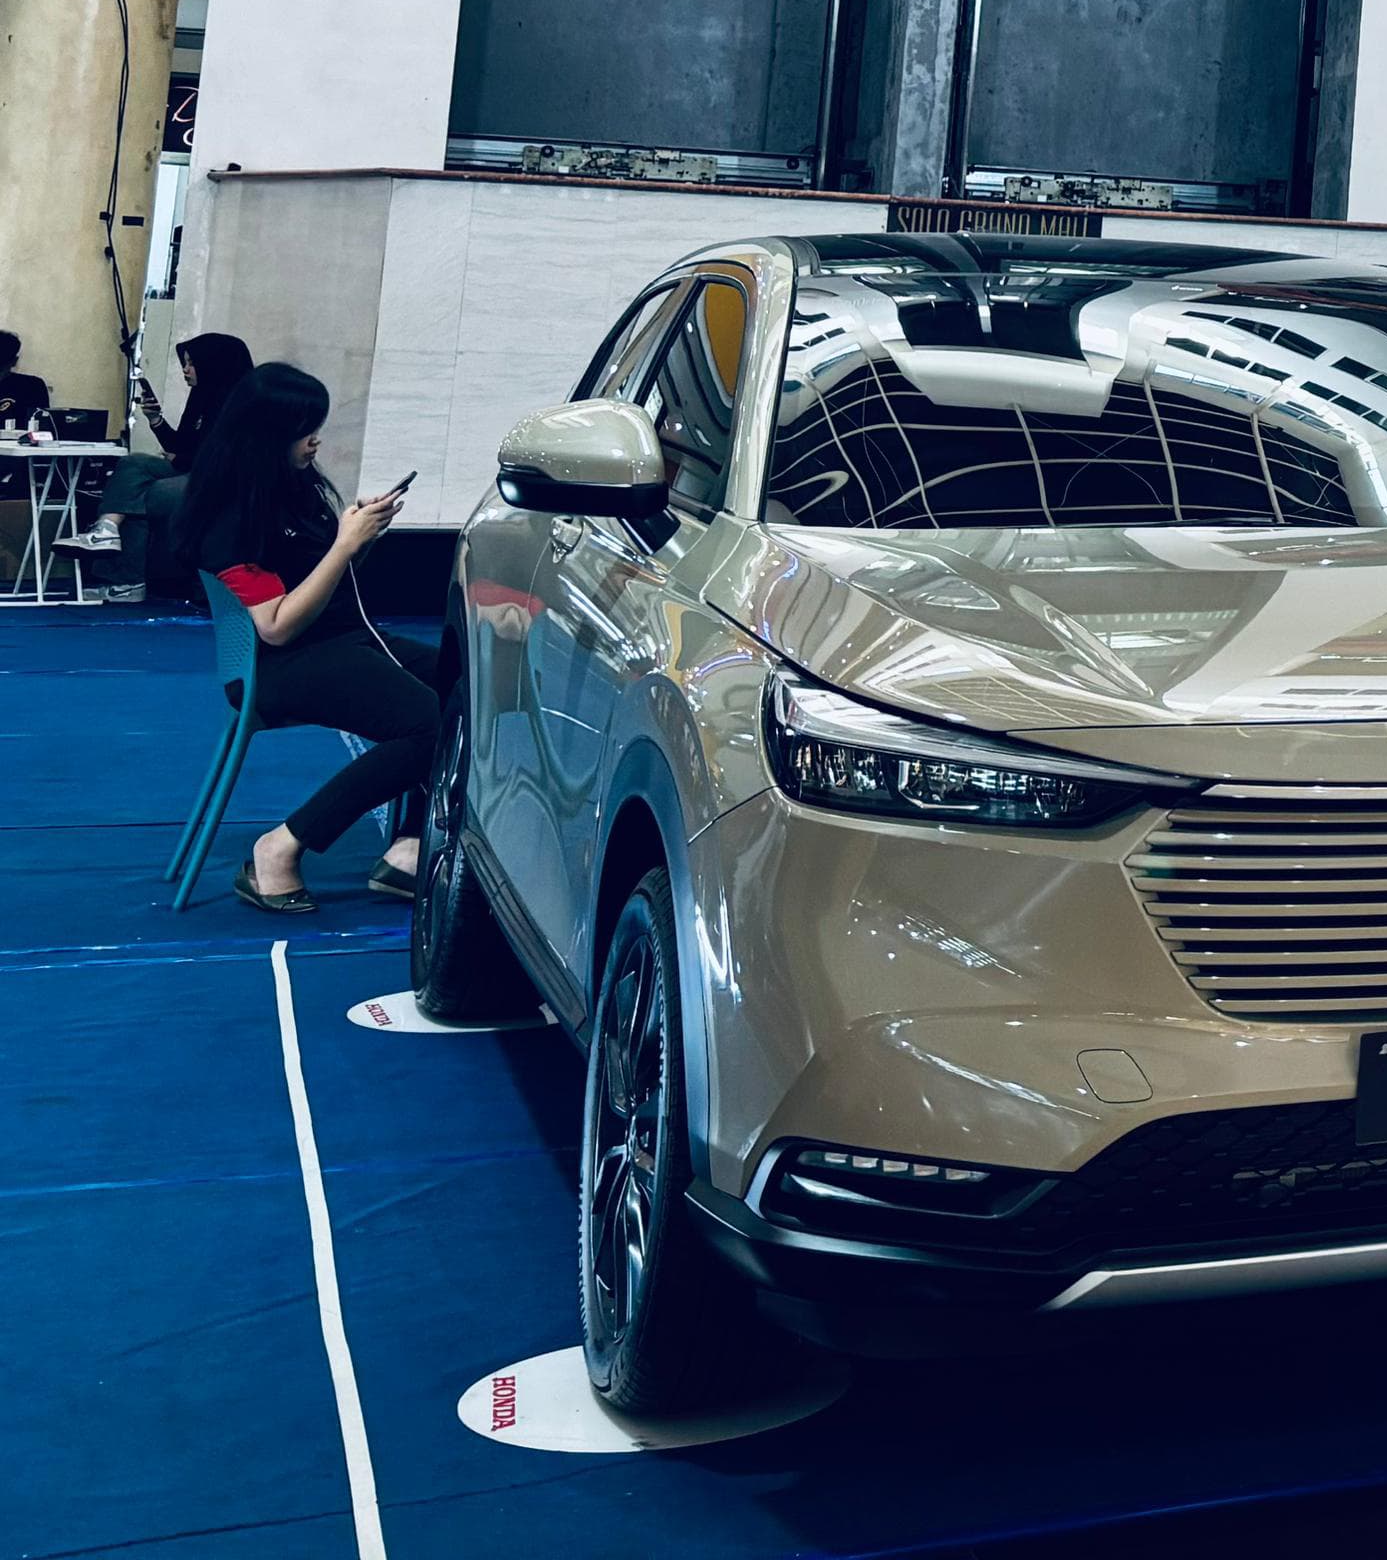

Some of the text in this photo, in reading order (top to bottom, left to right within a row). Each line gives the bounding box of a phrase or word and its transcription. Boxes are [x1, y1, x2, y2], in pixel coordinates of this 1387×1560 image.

[898, 206, 950, 233] SOLO
[960, 210, 1030, 235] GRAND
[491, 1376, 516, 1432] HONDA
